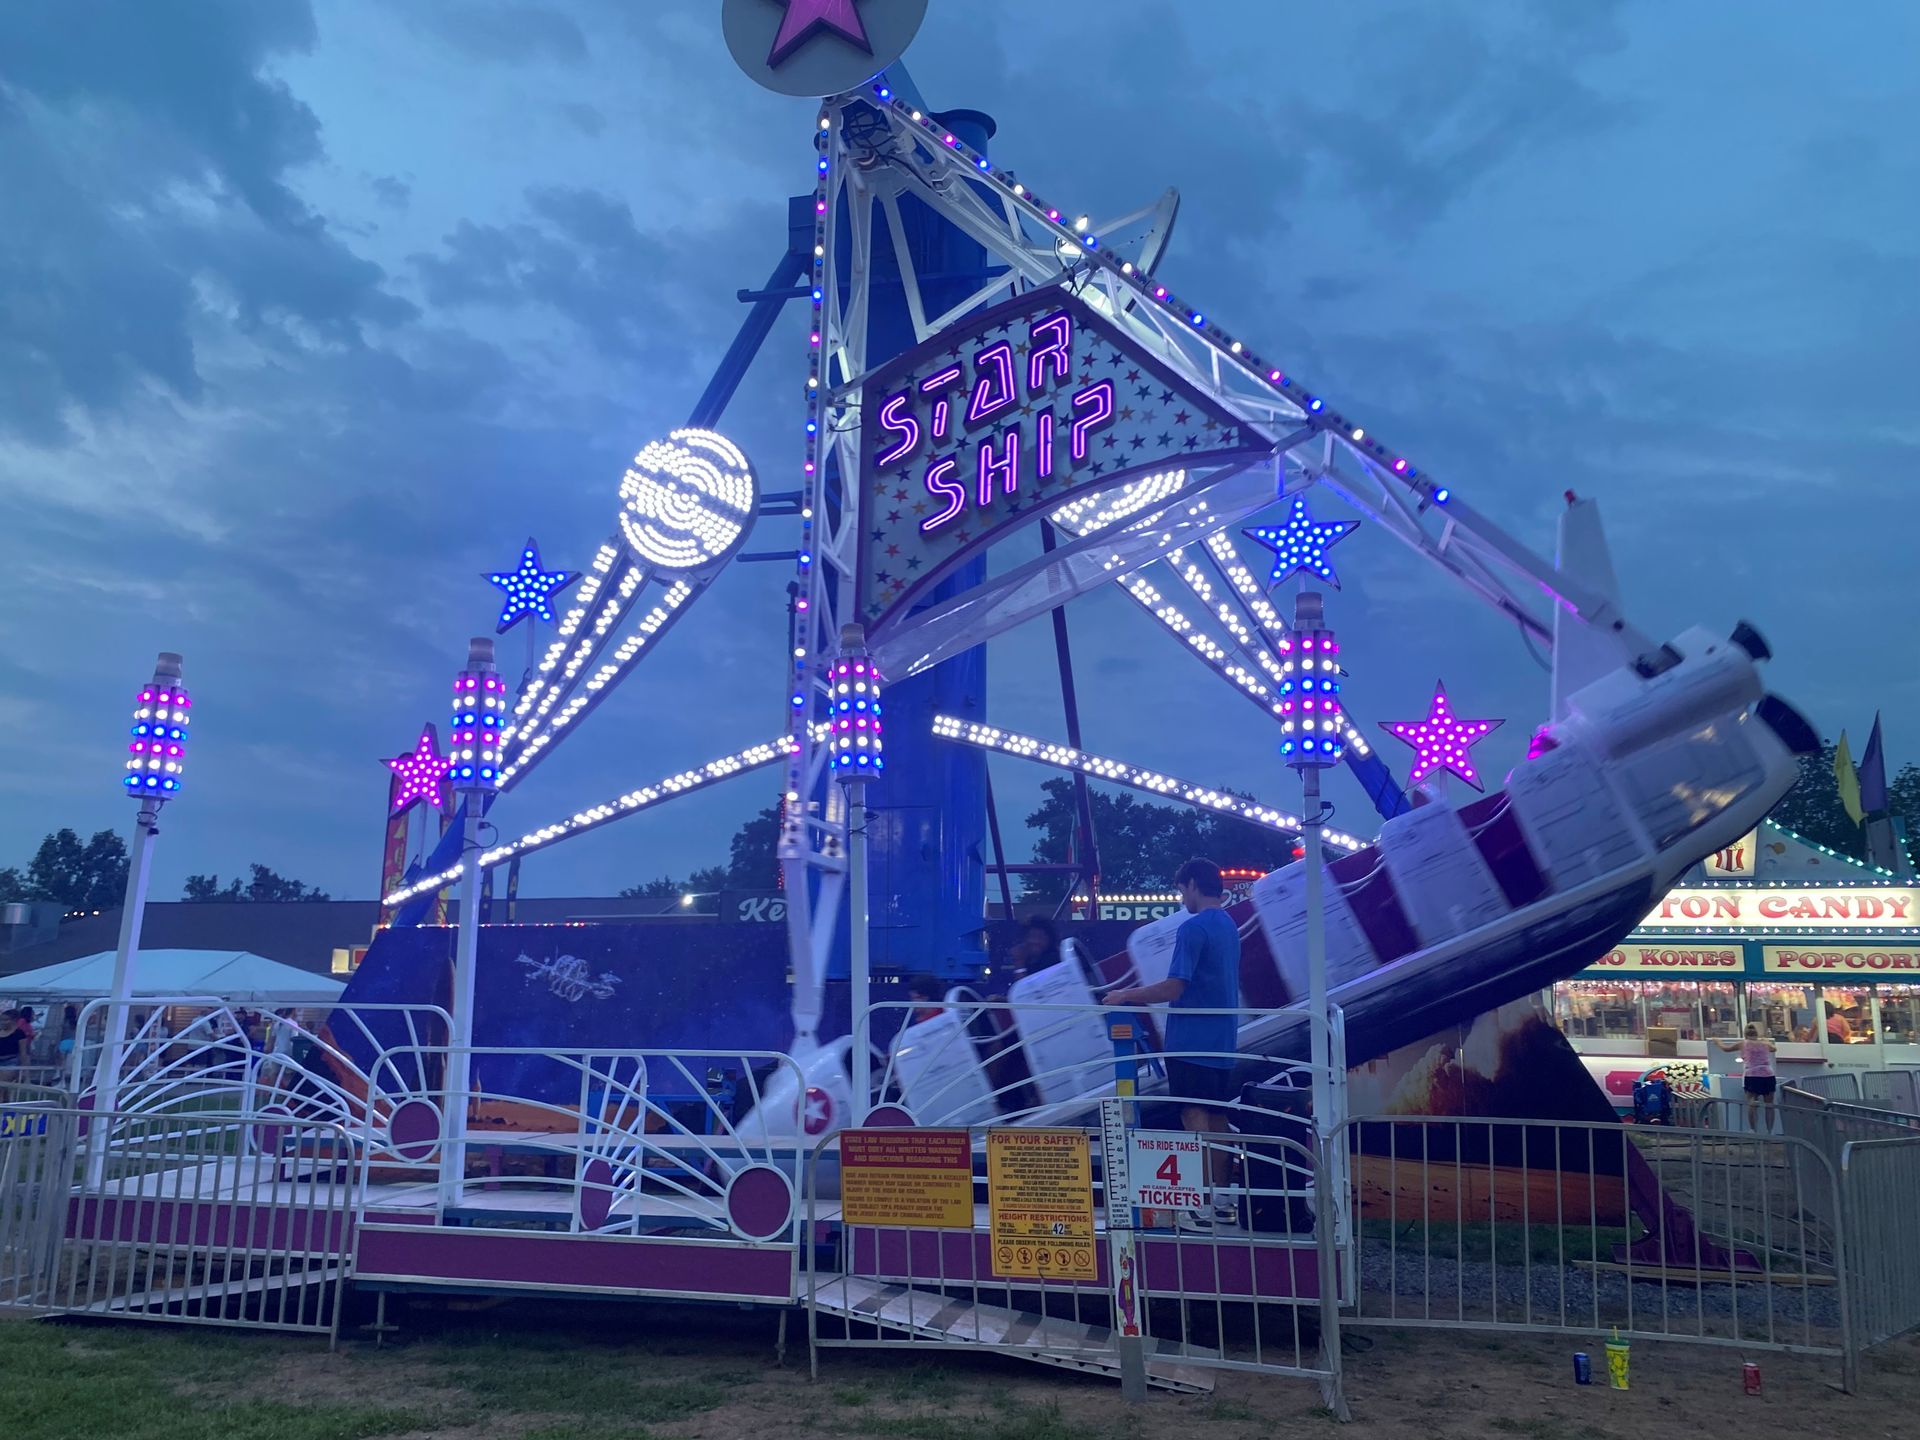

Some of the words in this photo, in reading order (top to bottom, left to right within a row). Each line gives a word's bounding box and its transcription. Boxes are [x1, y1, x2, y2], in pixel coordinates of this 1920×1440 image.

[875, 309, 1073, 467] STAR
[920, 378, 1115, 536] SHIP
[1758, 896, 1911, 918] CANDY
[1639, 949, 1736, 966] KONES
[1776, 950, 1920, 969] POPCOR
[992, 1135, 1012, 1144] FOR
[1013, 1135, 1040, 1144] YOUR
[1044, 1135, 1084, 1145] SAFETY:
[1138, 1140, 1154, 1149] THIS
[1157, 1141, 1173, 1150] RIDE
[1176, 1142, 1199, 1152] TAKES
[1157, 1155, 1181, 1185] 4
[1139, 1190, 1200, 1206] TICKETS
[999, 1213, 1027, 1221] HEIGHT
[1030, 1214, 1089, 1223] RESTRICTIONS:
[1053, 1223, 1064, 1234] 42
